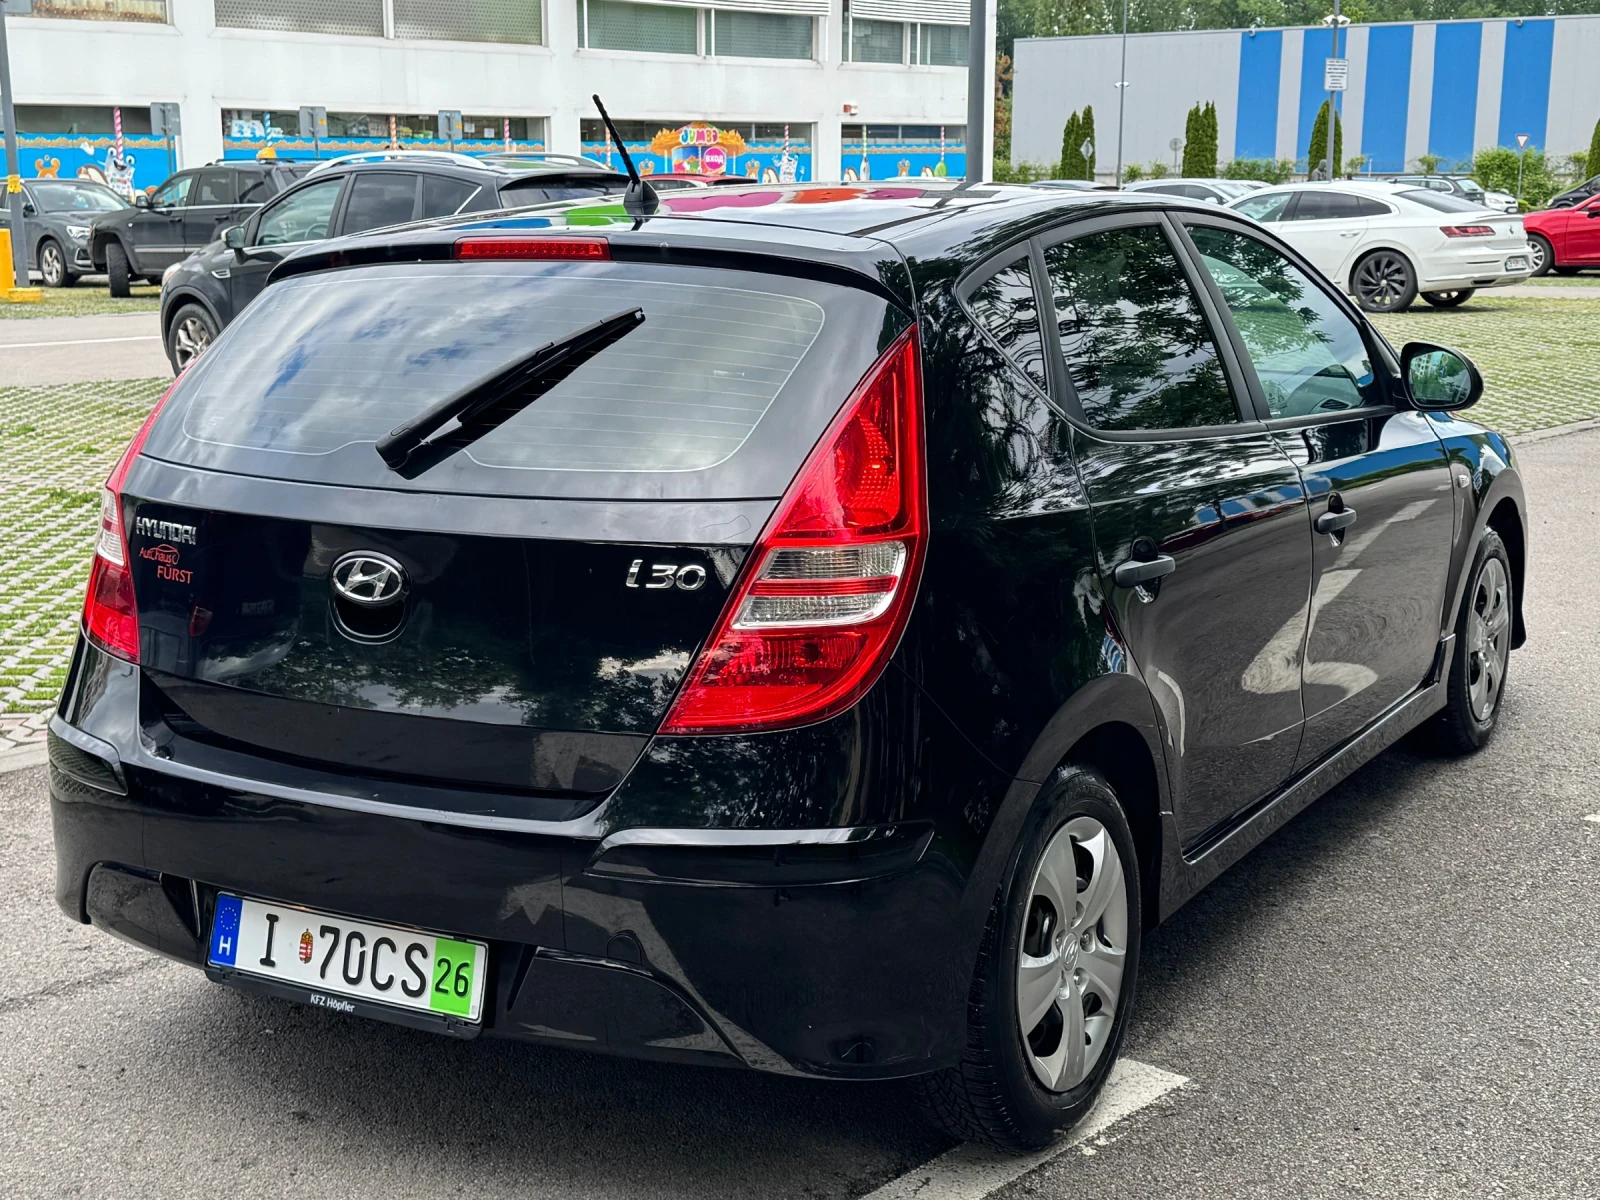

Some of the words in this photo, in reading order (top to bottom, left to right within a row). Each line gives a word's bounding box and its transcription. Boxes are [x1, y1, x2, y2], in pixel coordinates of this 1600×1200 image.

[680, 128, 719, 145] JUMBO
[136, 516, 197, 545] HYUNDAI
[157, 563, 193, 584] FÜRST
[219, 935, 231, 956] H
[260, 913, 279, 967] I
[435, 958, 469, 997] 26
[310, 993, 325, 1006] KFZ
